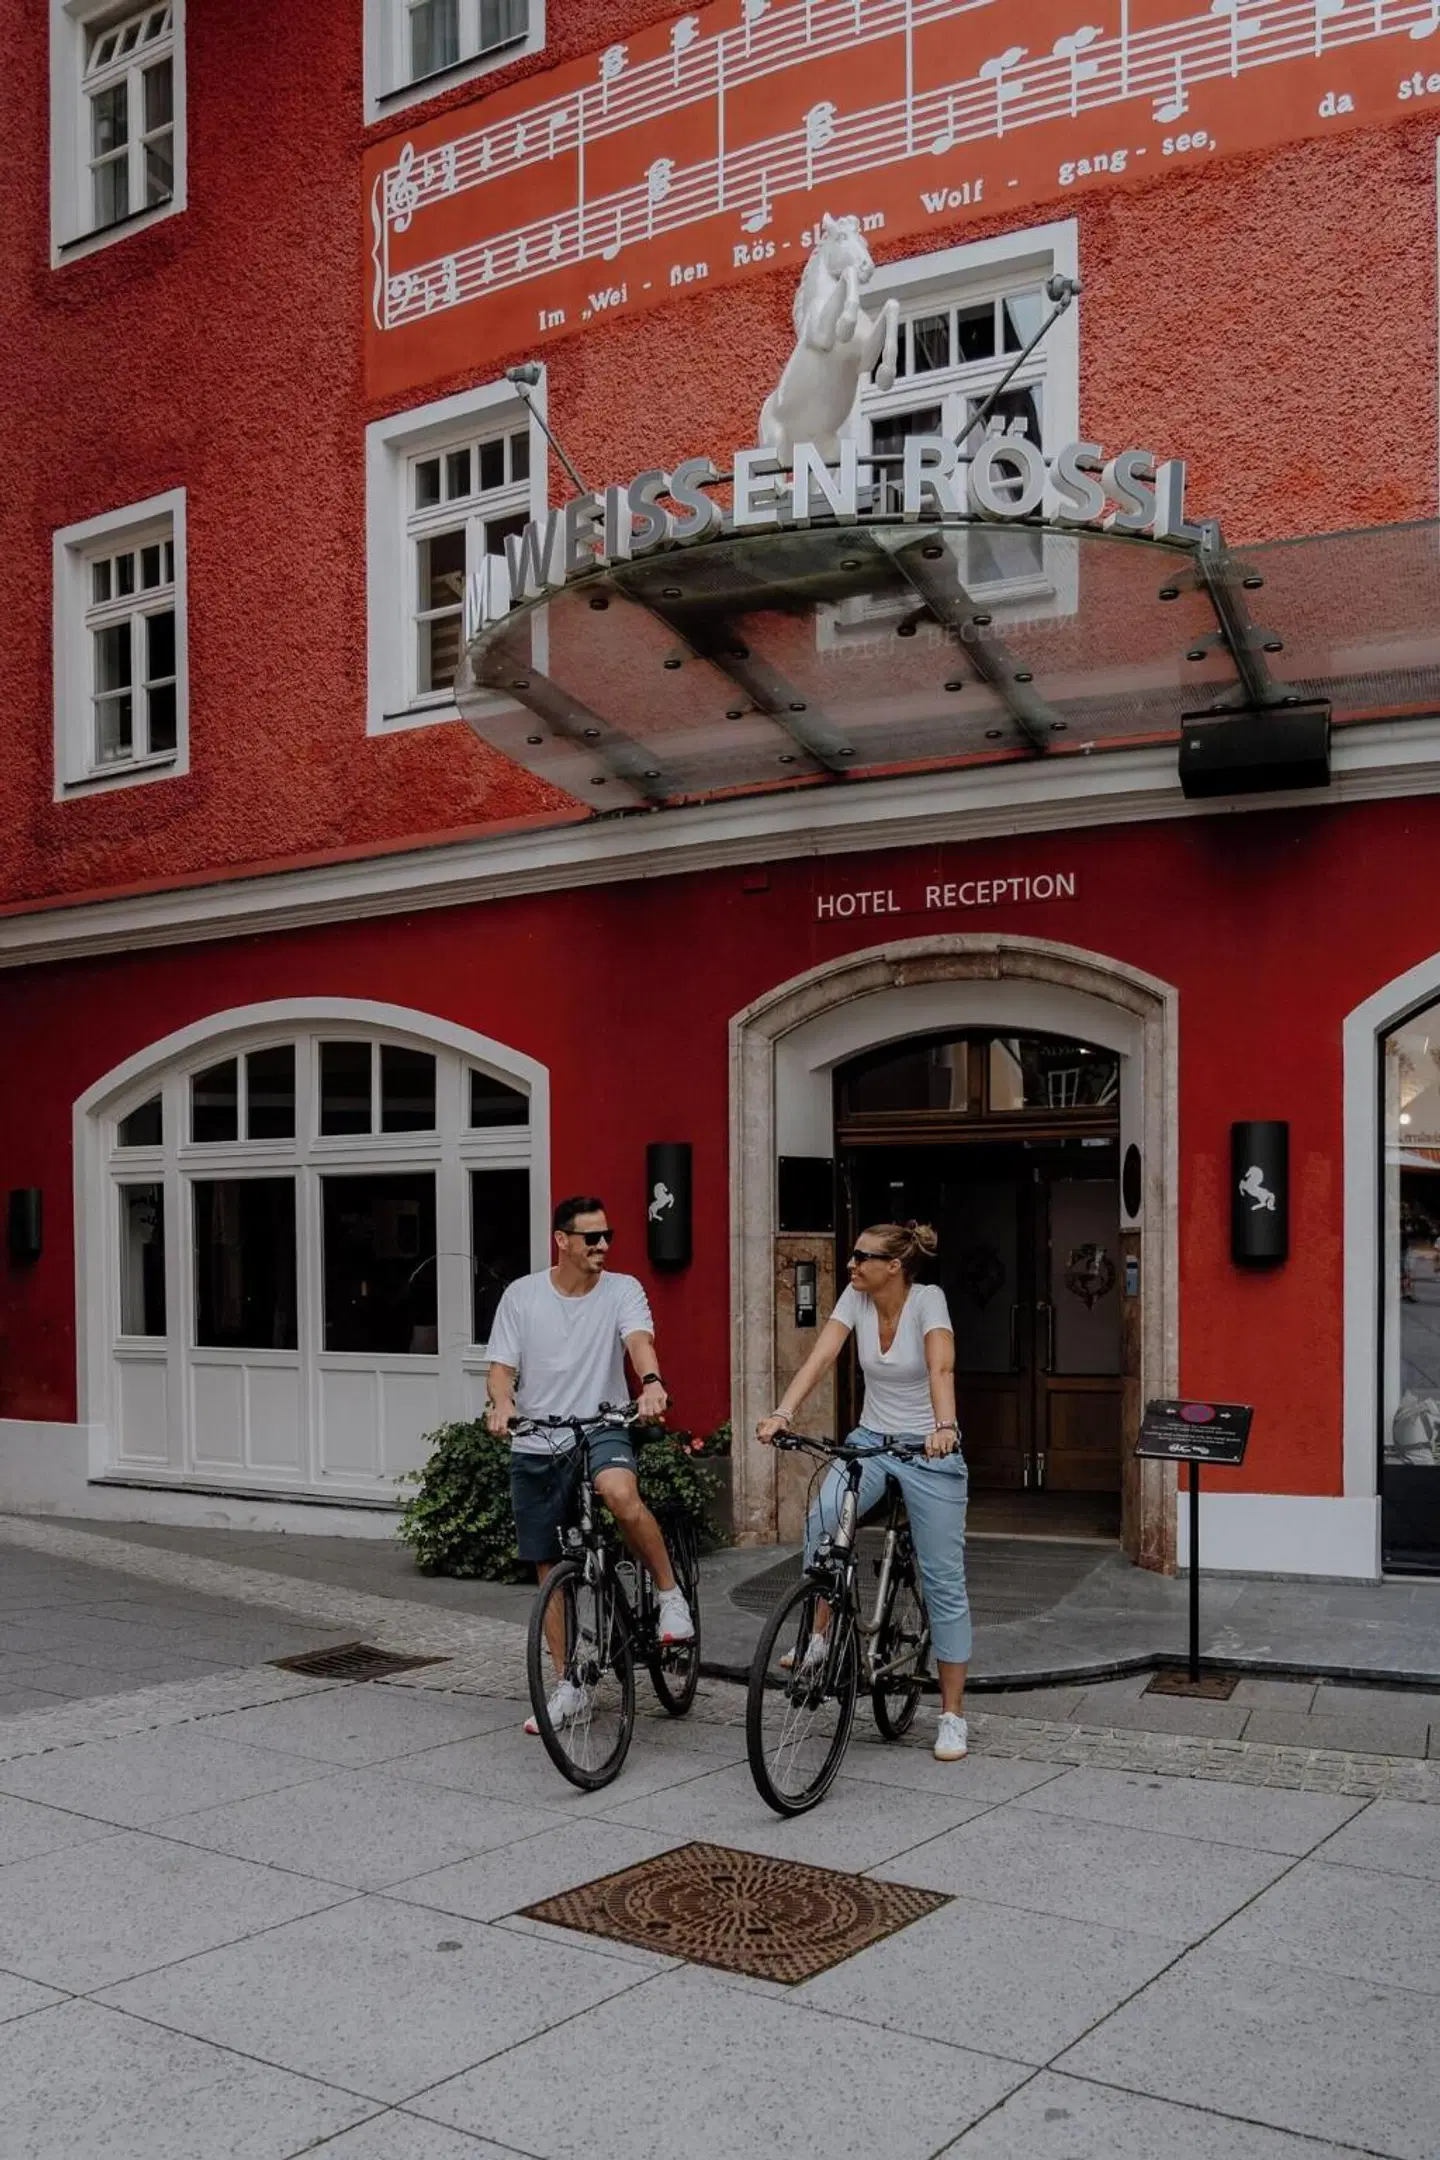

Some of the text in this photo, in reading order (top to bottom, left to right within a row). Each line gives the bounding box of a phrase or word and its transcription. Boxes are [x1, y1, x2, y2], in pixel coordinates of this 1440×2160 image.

[538, 309, 566, 331] Im
[670, 262, 709, 287] ßen
[919, 179, 984, 214] Wolf
[1058, 149, 1129, 186] gang
[1318, 91, 1355, 118] da
[503, 437, 859, 602] WEISSEN
[902, 415, 1204, 545] RÖSSL
[817, 872, 1075, 918] HOTEL RECEPTION
